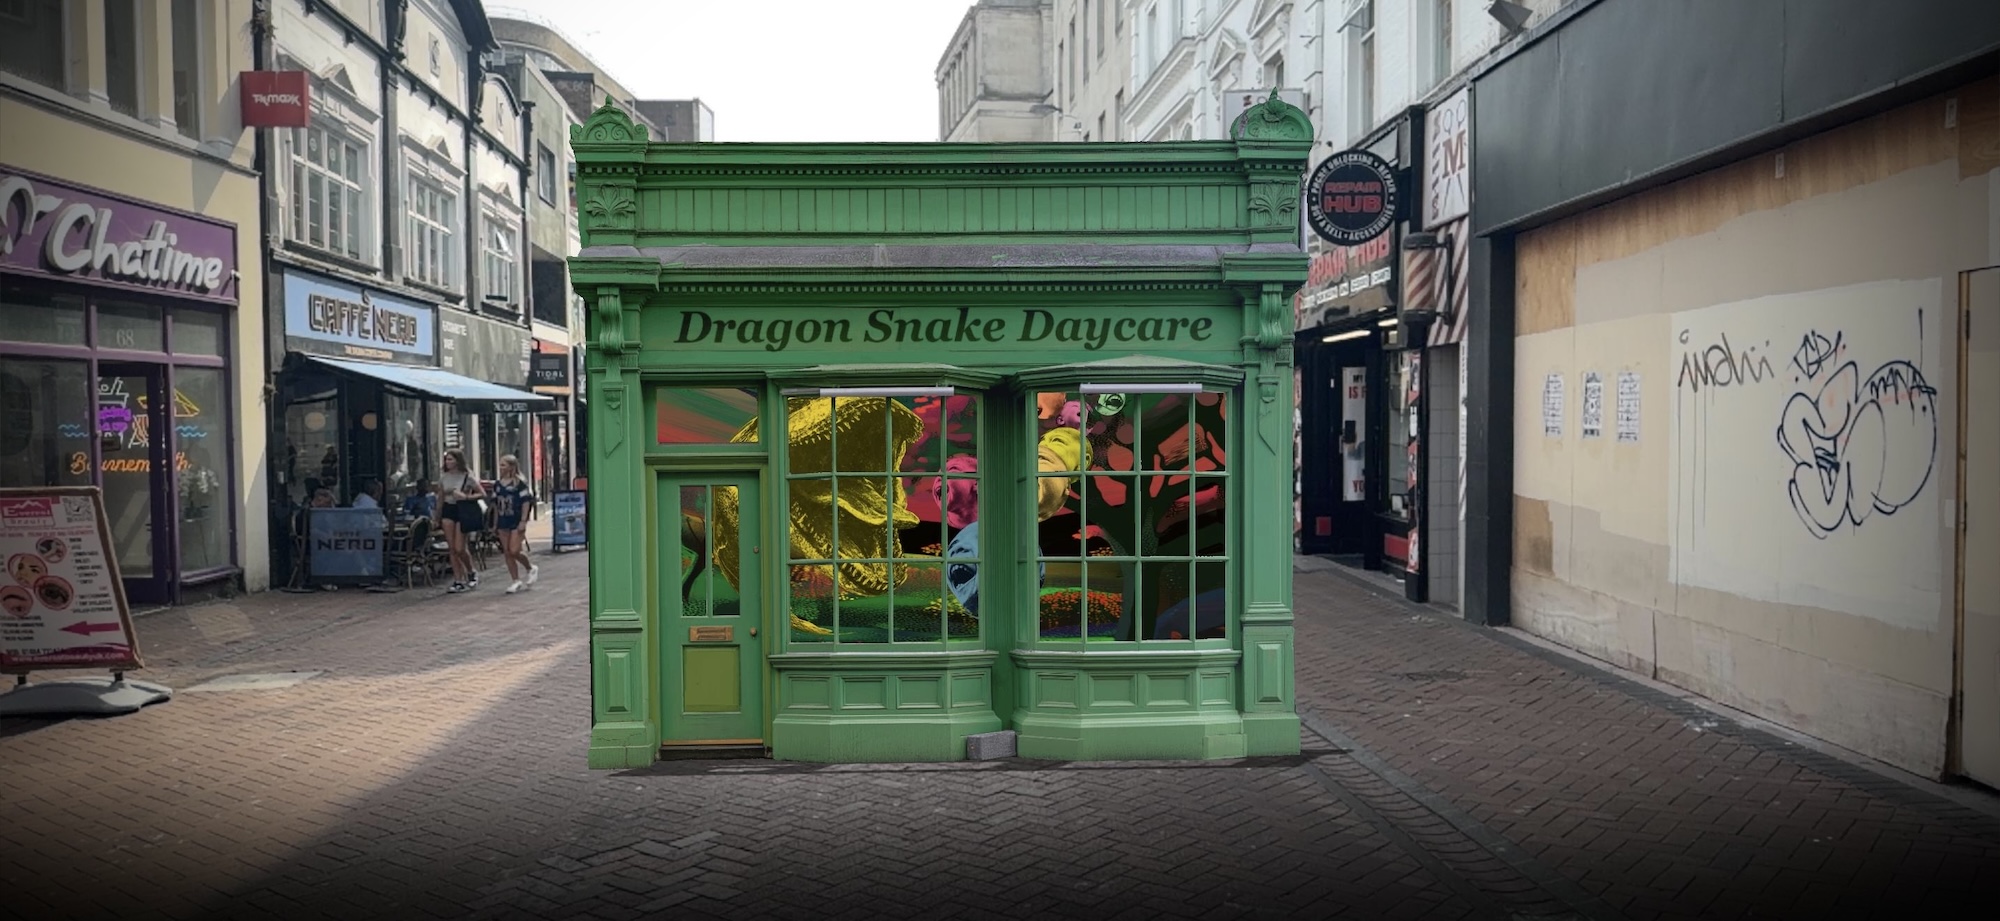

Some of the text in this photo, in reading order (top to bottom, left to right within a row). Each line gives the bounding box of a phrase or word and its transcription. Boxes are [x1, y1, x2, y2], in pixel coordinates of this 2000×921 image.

[1324, 182, 1382, 193] REPAIR
[1323, 195, 1382, 213] HUB
[47, 203, 222, 289] Chatime
[373, 305, 417, 347] NERO
[673, 307, 1212, 352] Dragon Snake Daycare
[117, 328, 134, 347] 68
[317, 539, 375, 550] NERO
